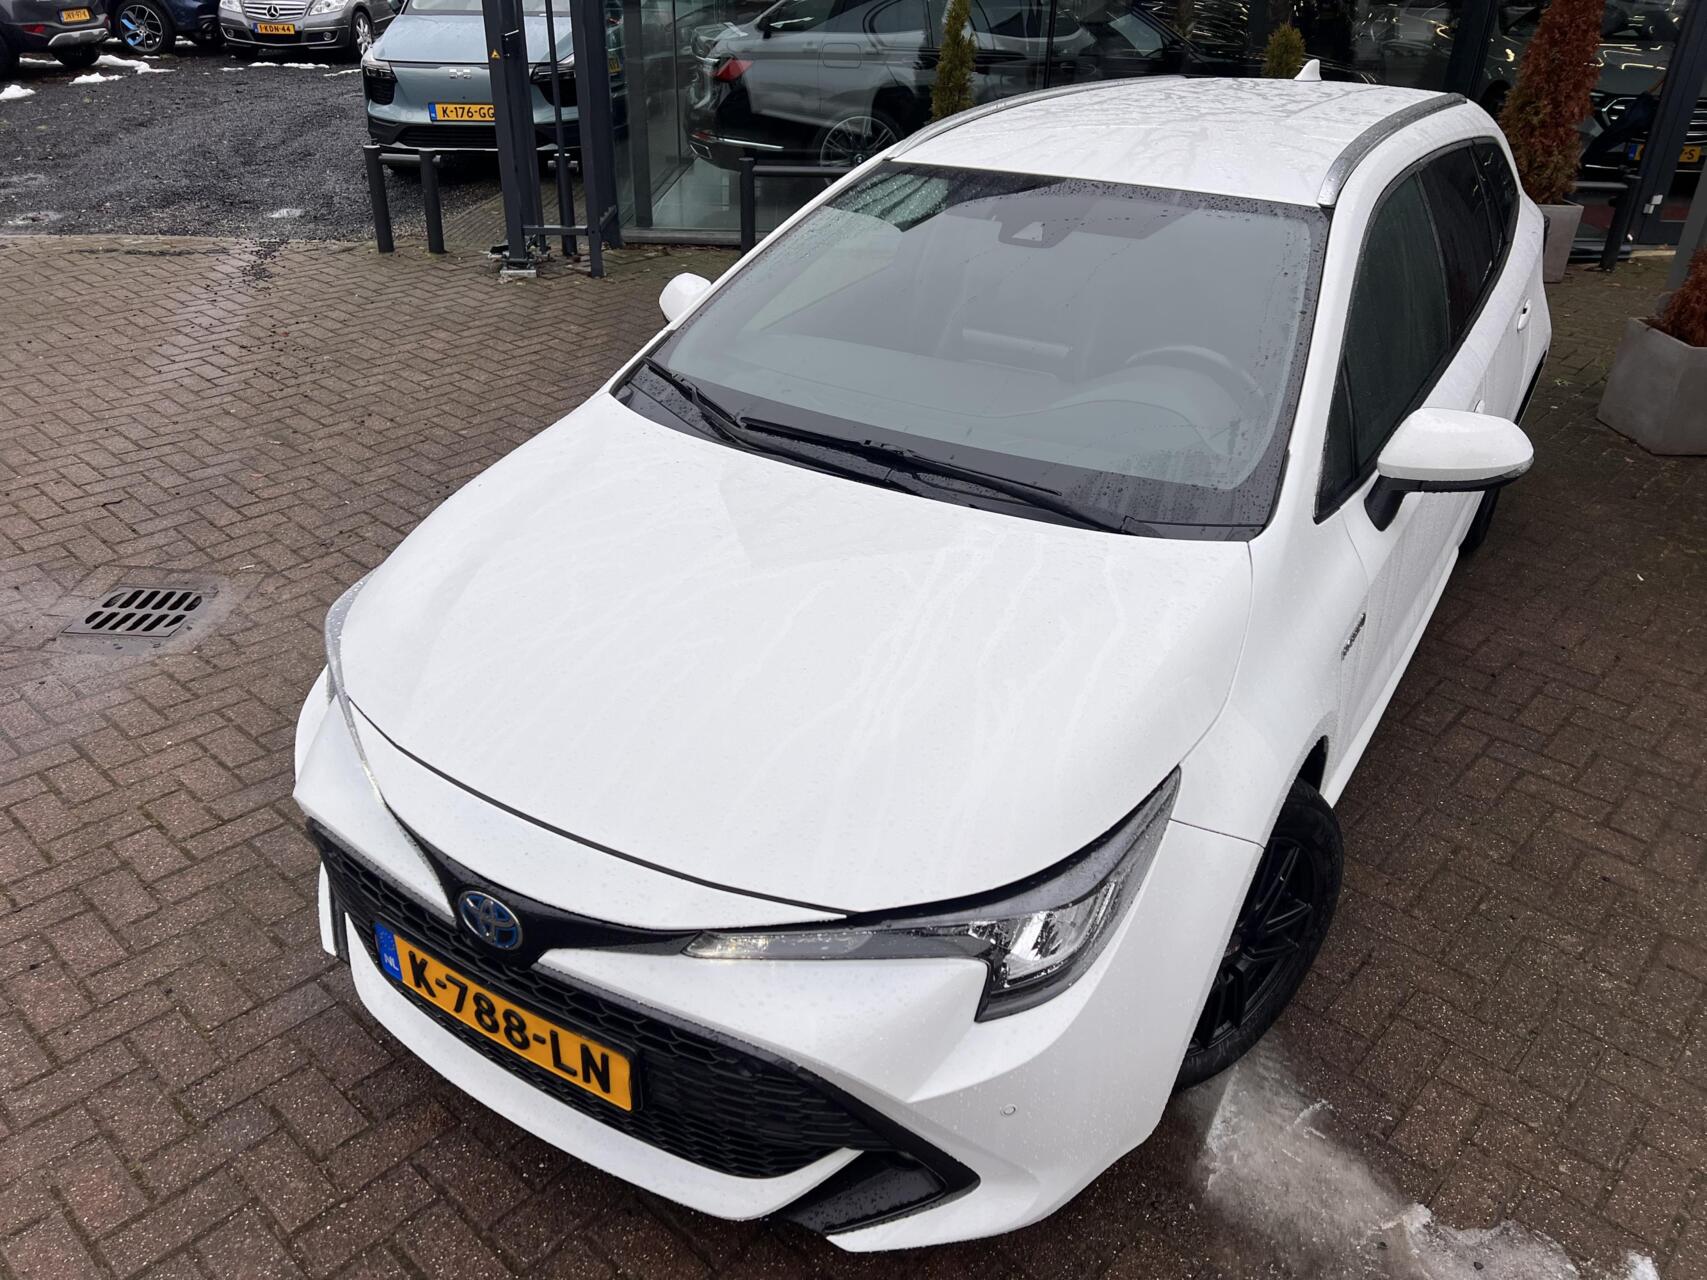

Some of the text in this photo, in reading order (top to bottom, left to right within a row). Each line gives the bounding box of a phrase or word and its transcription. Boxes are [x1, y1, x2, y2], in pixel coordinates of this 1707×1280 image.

[441, 106, 496, 119] K-176-GG
[383, 952, 400, 971] NL
[408, 950, 611, 1094] K-788-LN
